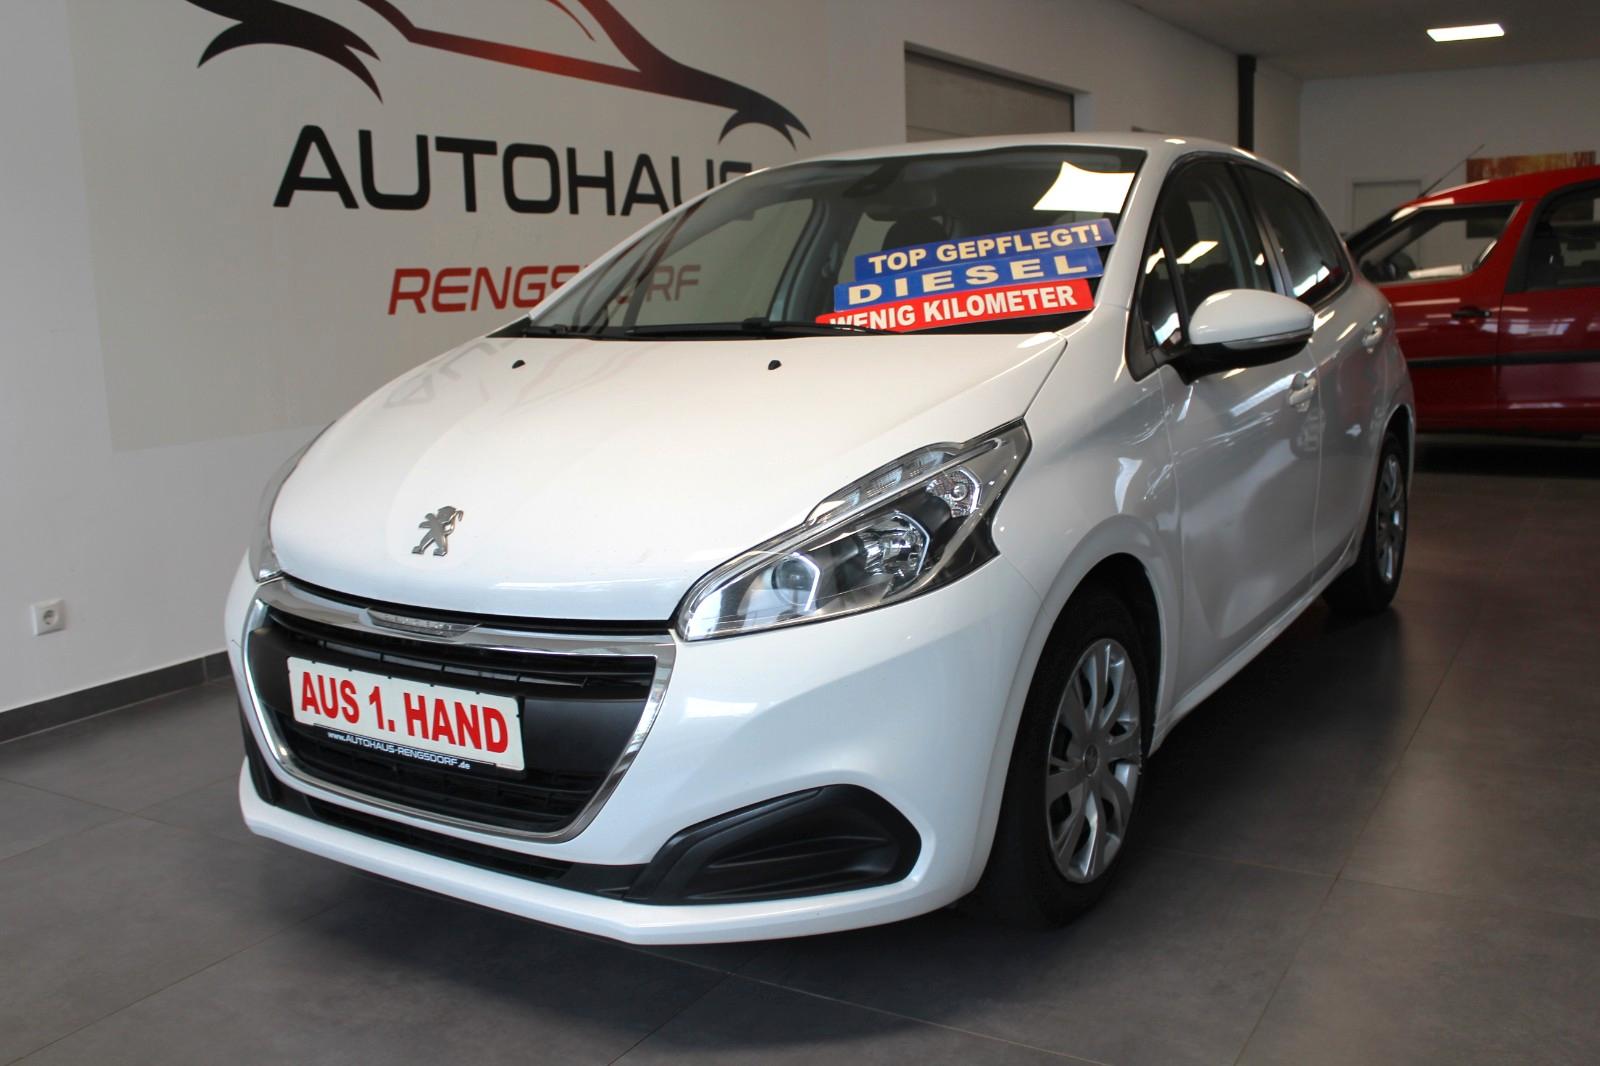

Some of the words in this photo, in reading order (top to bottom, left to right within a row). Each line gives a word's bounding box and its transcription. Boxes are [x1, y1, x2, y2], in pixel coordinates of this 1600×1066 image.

[867, 248, 928, 275] TOP
[936, 224, 1102, 263] GEPFLEGT!
[848, 255, 1088, 306] DIESEL
[923, 285, 1077, 323] KILOMETER
[301, 671, 360, 725] AUS
[368, 686, 396, 733] 1.
[403, 692, 509, 754] HAND
